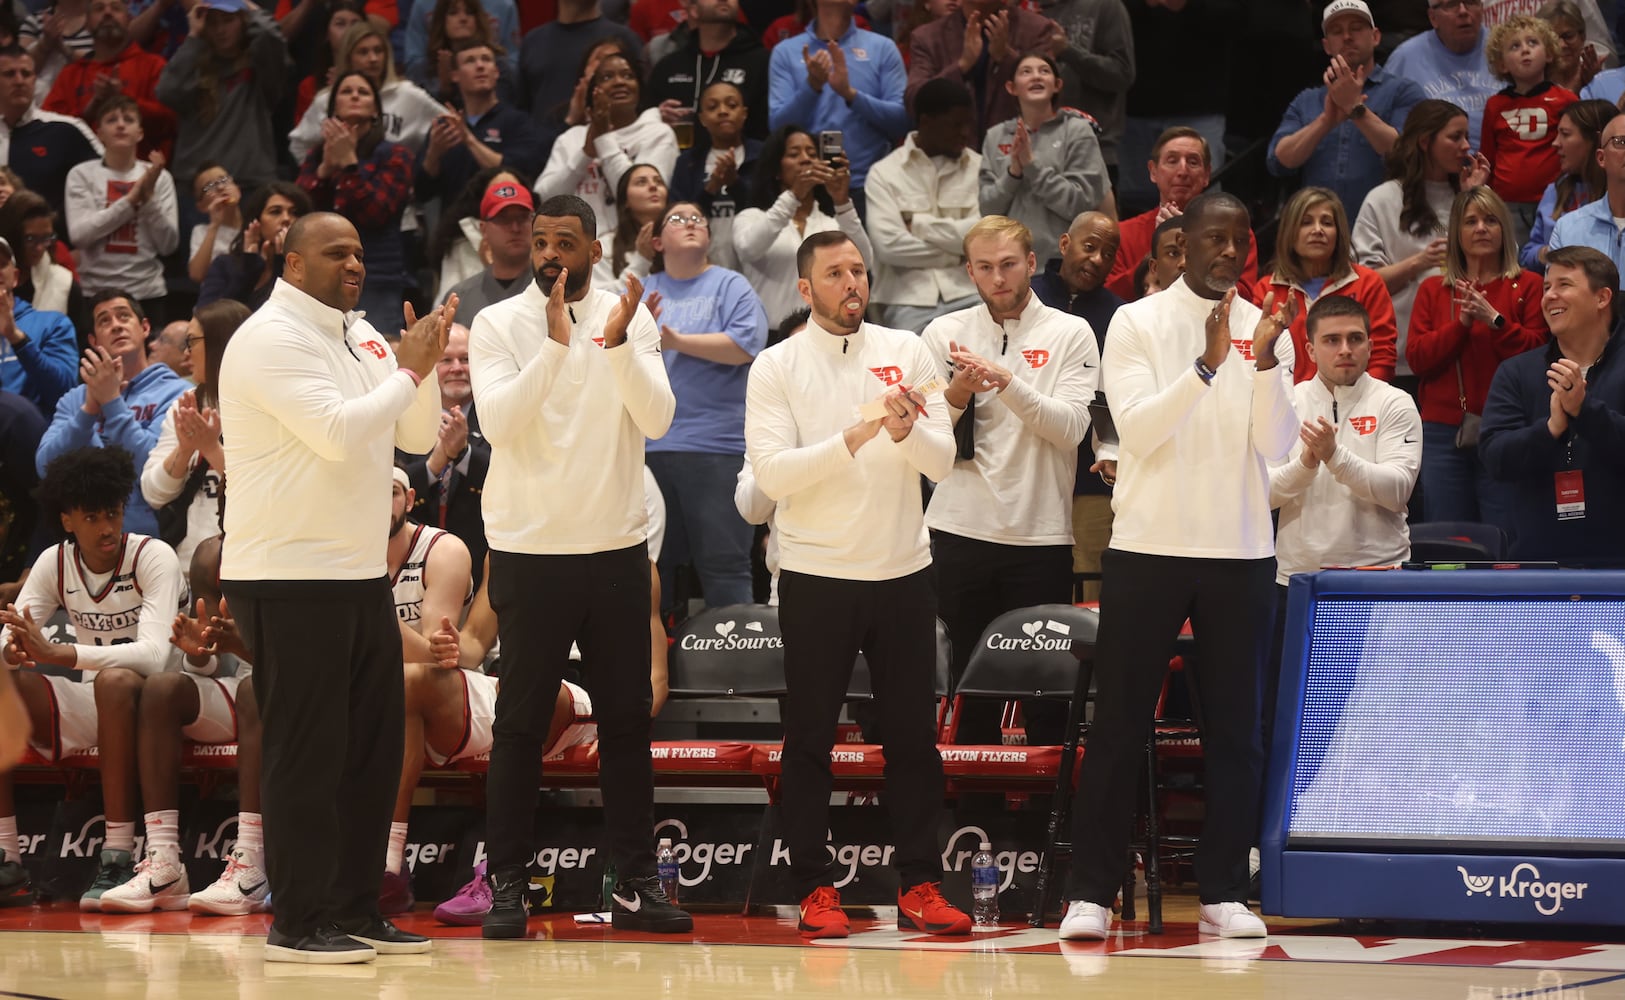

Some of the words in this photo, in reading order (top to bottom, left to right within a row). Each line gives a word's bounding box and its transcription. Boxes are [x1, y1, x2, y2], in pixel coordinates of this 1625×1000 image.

[193, 745, 239, 756] DAYTON
[671, 748, 717, 759] FLYERS
[981, 751, 1028, 763] FLYERS
[1500, 863, 1588, 916] Kroger
